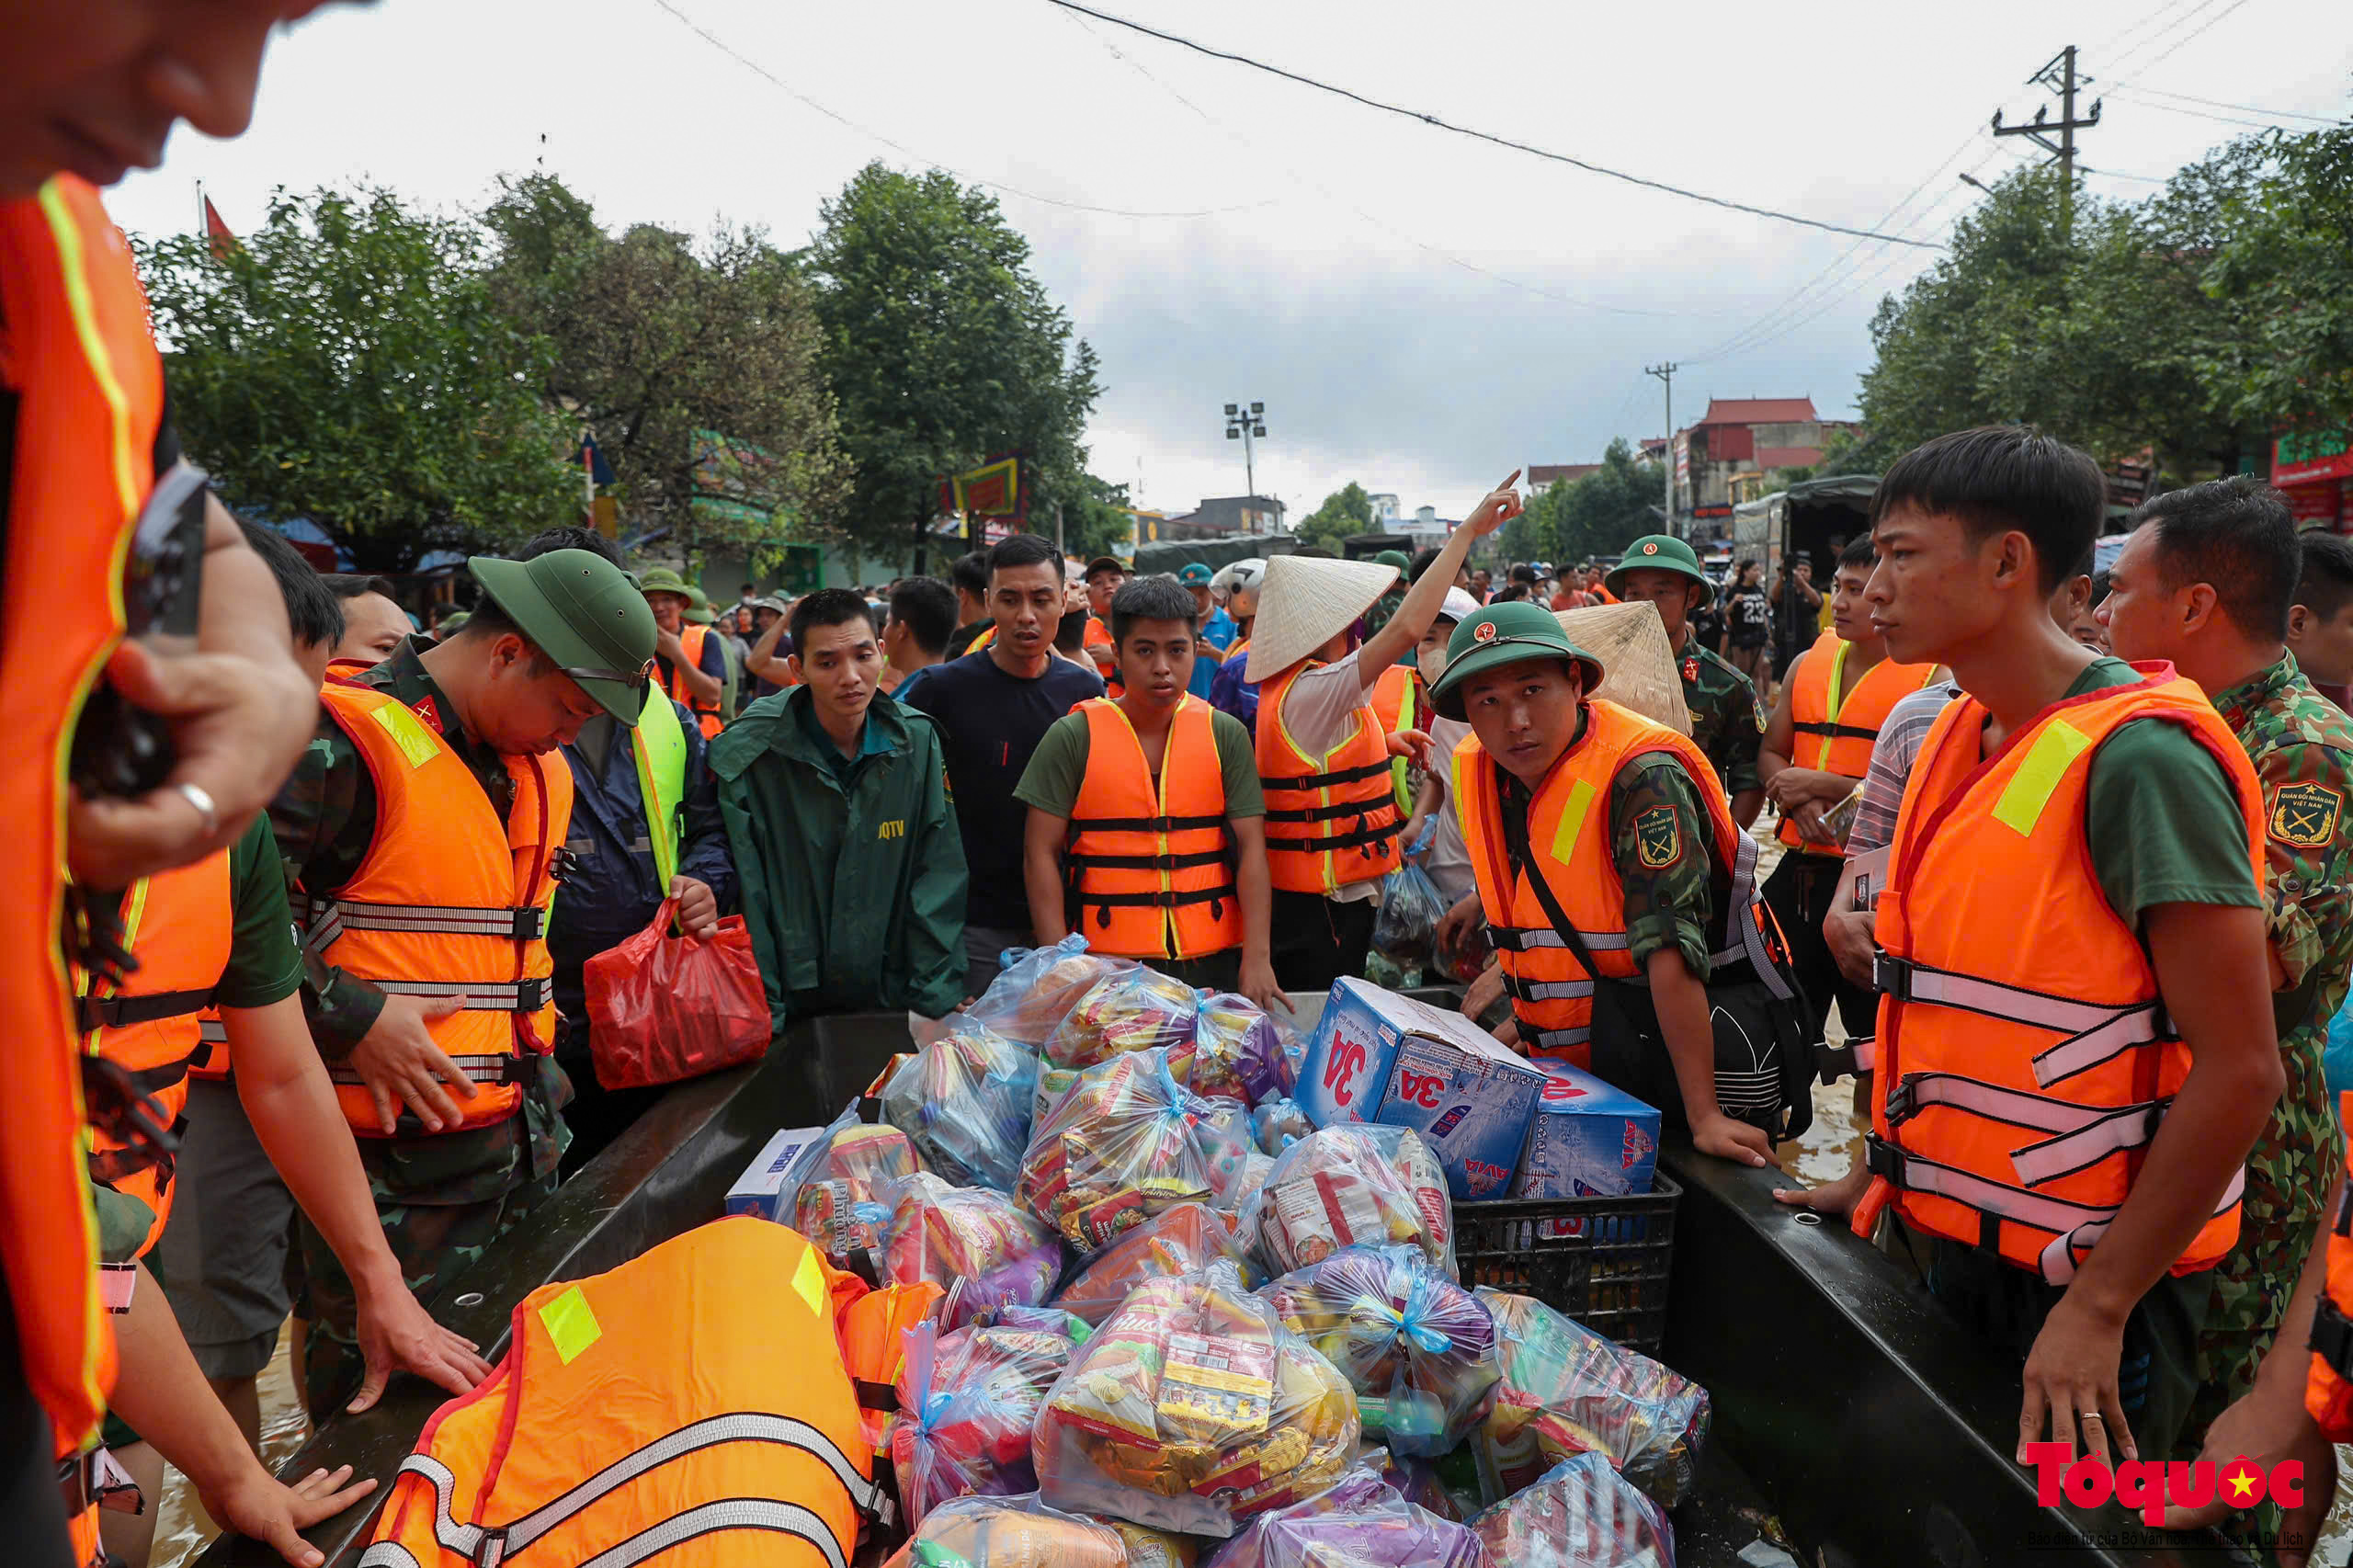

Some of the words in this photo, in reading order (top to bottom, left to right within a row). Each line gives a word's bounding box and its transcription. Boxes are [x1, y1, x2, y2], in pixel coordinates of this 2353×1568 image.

[1743, 601, 1765, 623] 23
[1323, 1028, 1367, 1108] 3A
[1400, 1069, 1445, 1108] 3A
[1622, 1118, 1637, 1169] AVIA
[1464, 1157, 1508, 1181] AVIA
